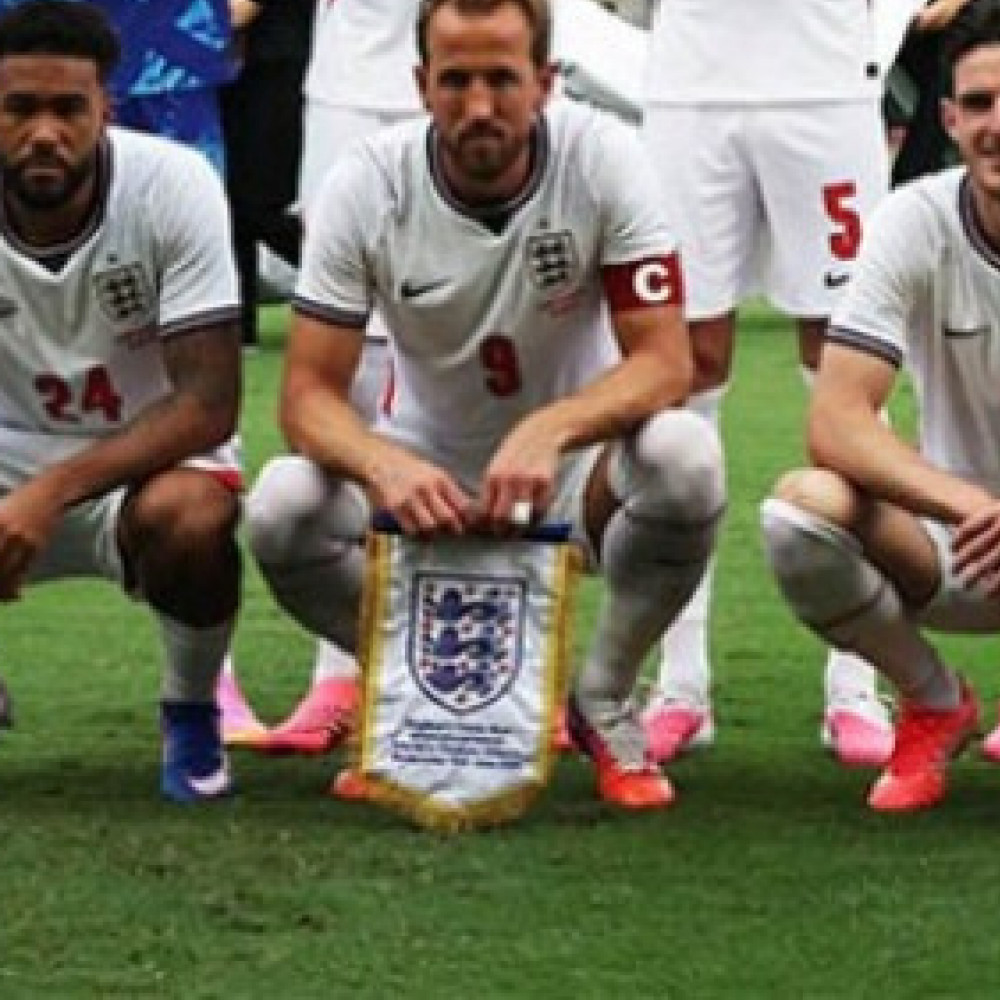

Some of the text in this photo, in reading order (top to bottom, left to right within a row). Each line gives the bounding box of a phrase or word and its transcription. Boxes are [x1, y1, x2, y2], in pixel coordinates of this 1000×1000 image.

[822, 182, 864, 262] 5
[632, 261, 671, 303] C
[33, 365, 123, 424] 24
[479, 335, 522, 398] 9
